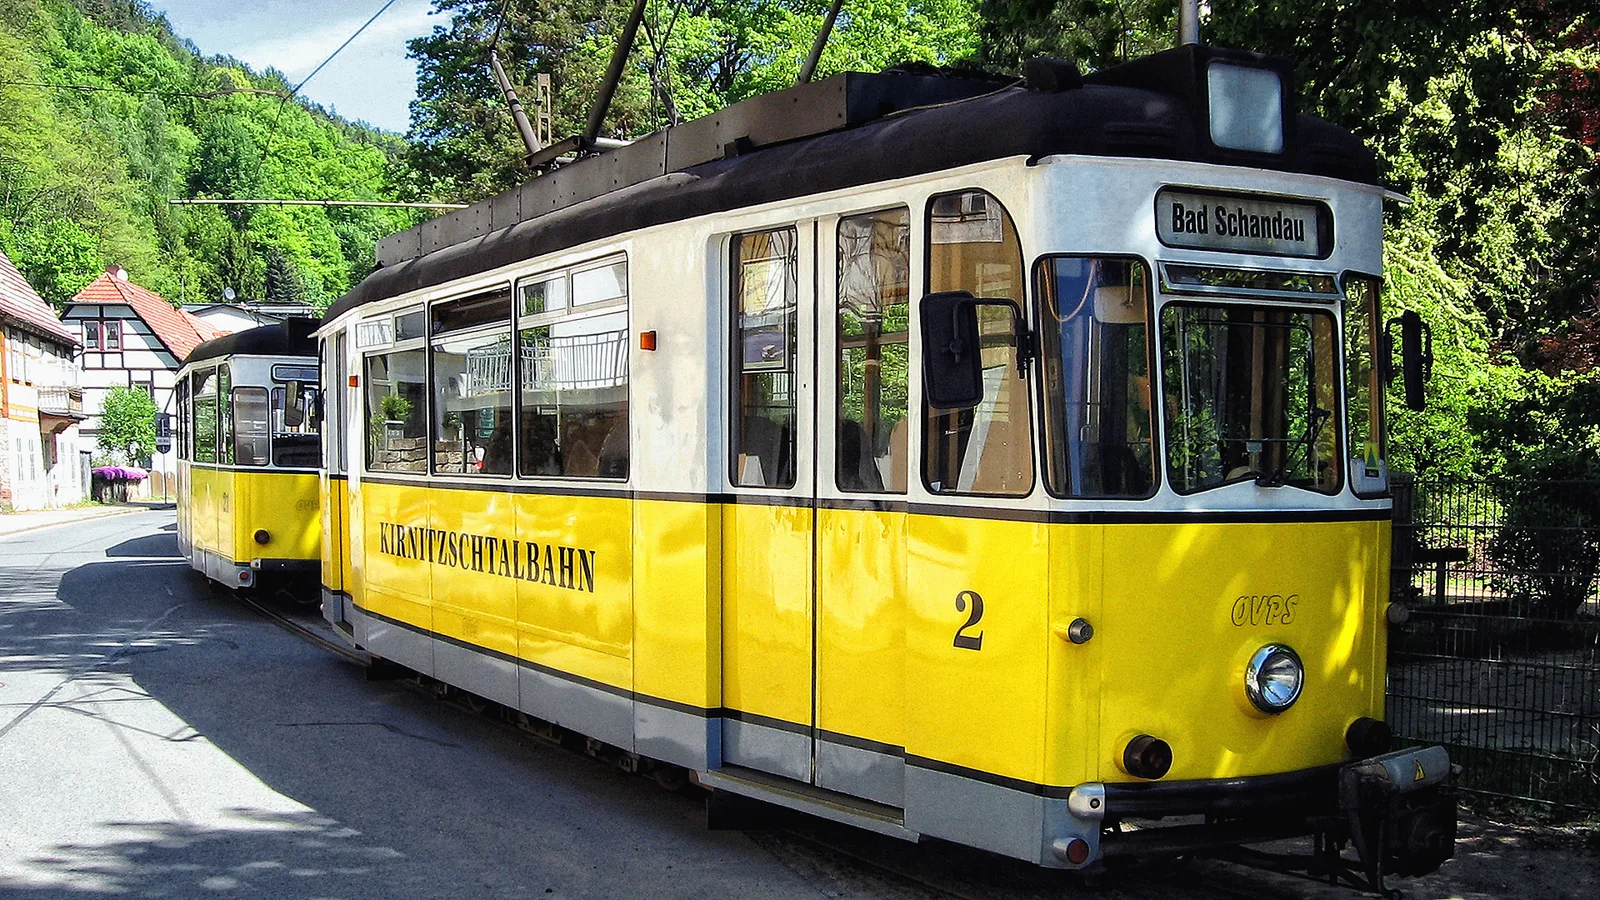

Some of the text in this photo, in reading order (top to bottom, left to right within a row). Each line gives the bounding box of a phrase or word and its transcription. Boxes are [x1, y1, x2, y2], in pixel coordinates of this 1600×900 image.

[1172, 203, 1305, 242] Bad Schandau
[380, 522, 596, 593] KIRNITZSCHTALBAHN
[953, 590, 984, 651] 2
[1231, 594, 1299, 627] OVPS
